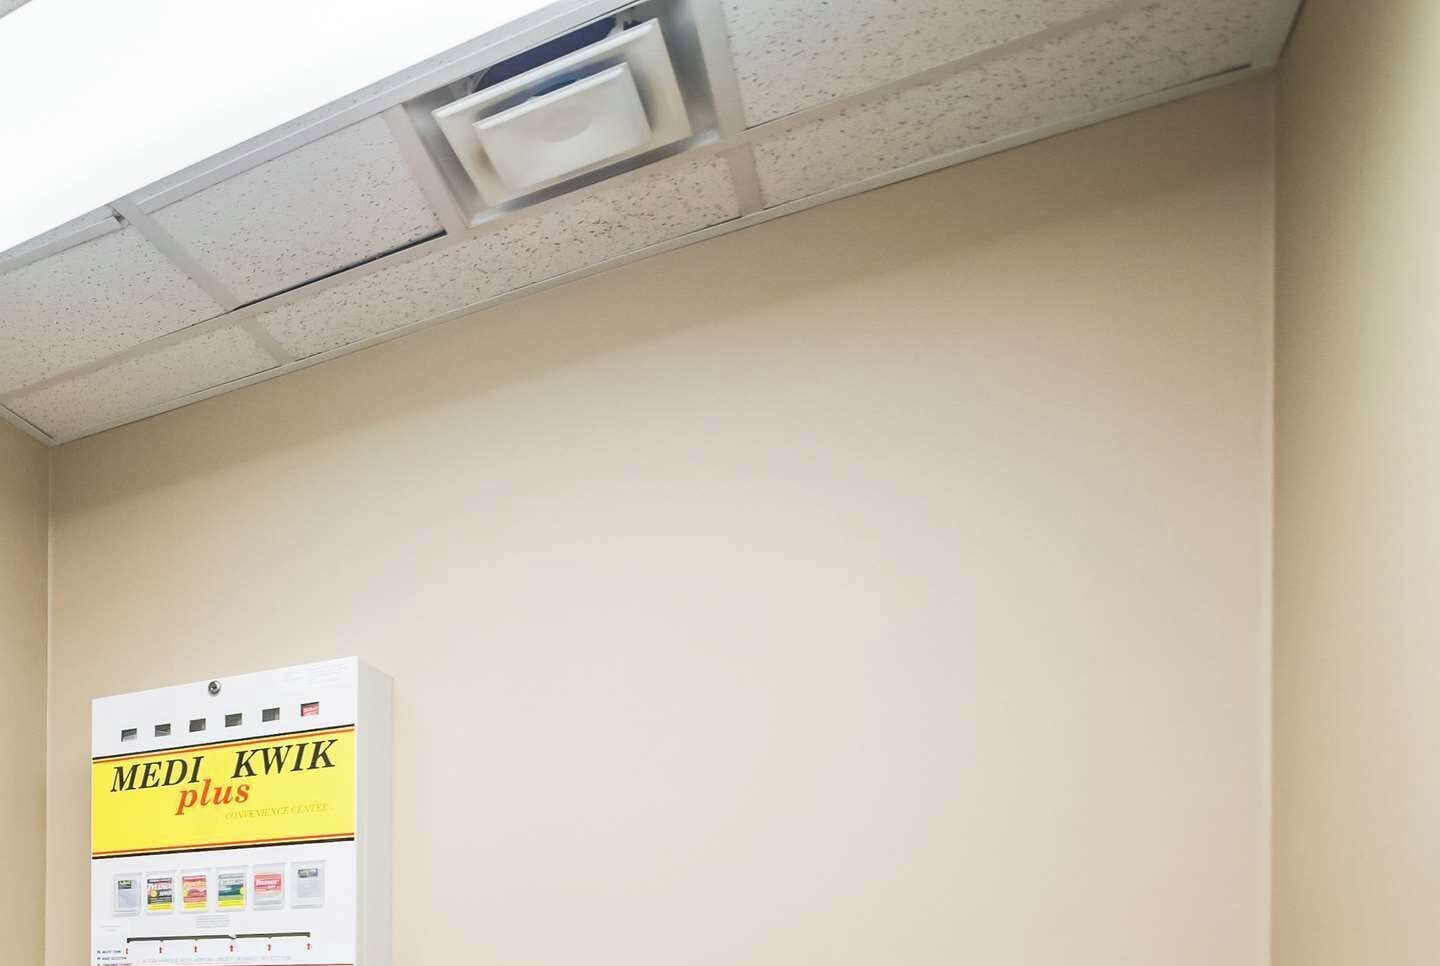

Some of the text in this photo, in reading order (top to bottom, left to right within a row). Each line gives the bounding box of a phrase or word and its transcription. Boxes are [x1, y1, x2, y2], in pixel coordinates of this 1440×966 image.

[110, 739, 338, 793] MEDI KWIK
[175, 778, 251, 816] plus
[224, 802, 330, 820] CONVENIENCE CENTER
